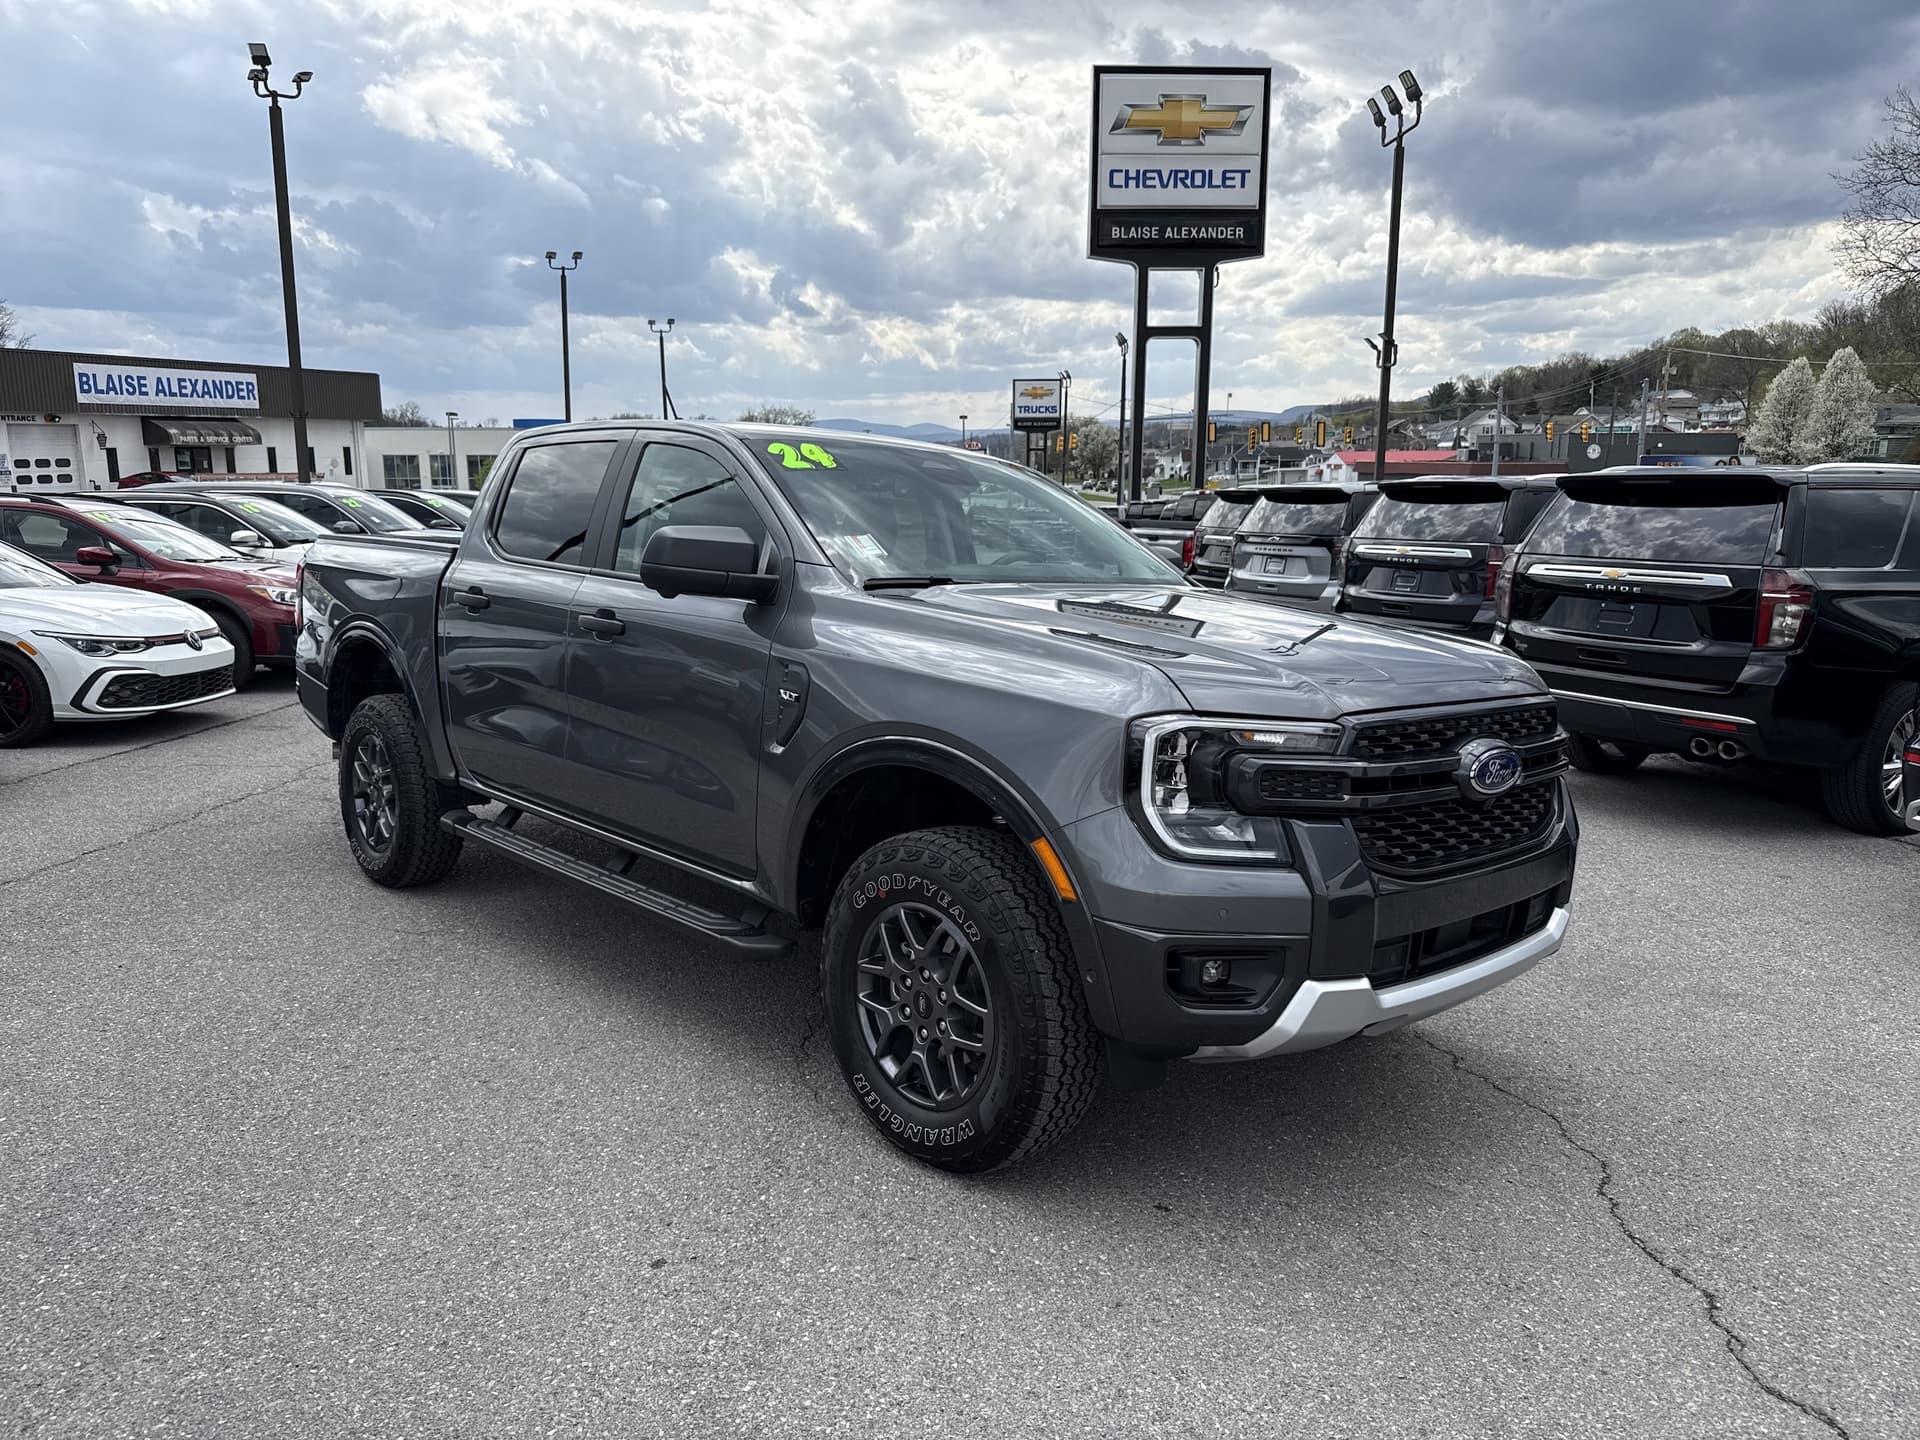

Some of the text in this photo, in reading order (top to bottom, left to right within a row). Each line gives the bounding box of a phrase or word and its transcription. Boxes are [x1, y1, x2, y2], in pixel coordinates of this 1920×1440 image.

[1108, 168, 1251, 189] CHEVROLET
[1111, 227, 1245, 239] BLAISE ALEXANDER
[77, 372, 258, 401] BLAISE ALEXANDER
[0, 414, 37, 422] NTRANCE
[1017, 405, 1058, 414] TRUCKS
[767, 443, 838, 469] 24
[1386, 556, 1420, 564] TAHOE
[1584, 583, 1642, 594] TAHOE
[1485, 759, 1514, 784] Ford
[853, 873, 981, 942] GOODYEAR
[852, 1073, 975, 1146] WRANGLER
